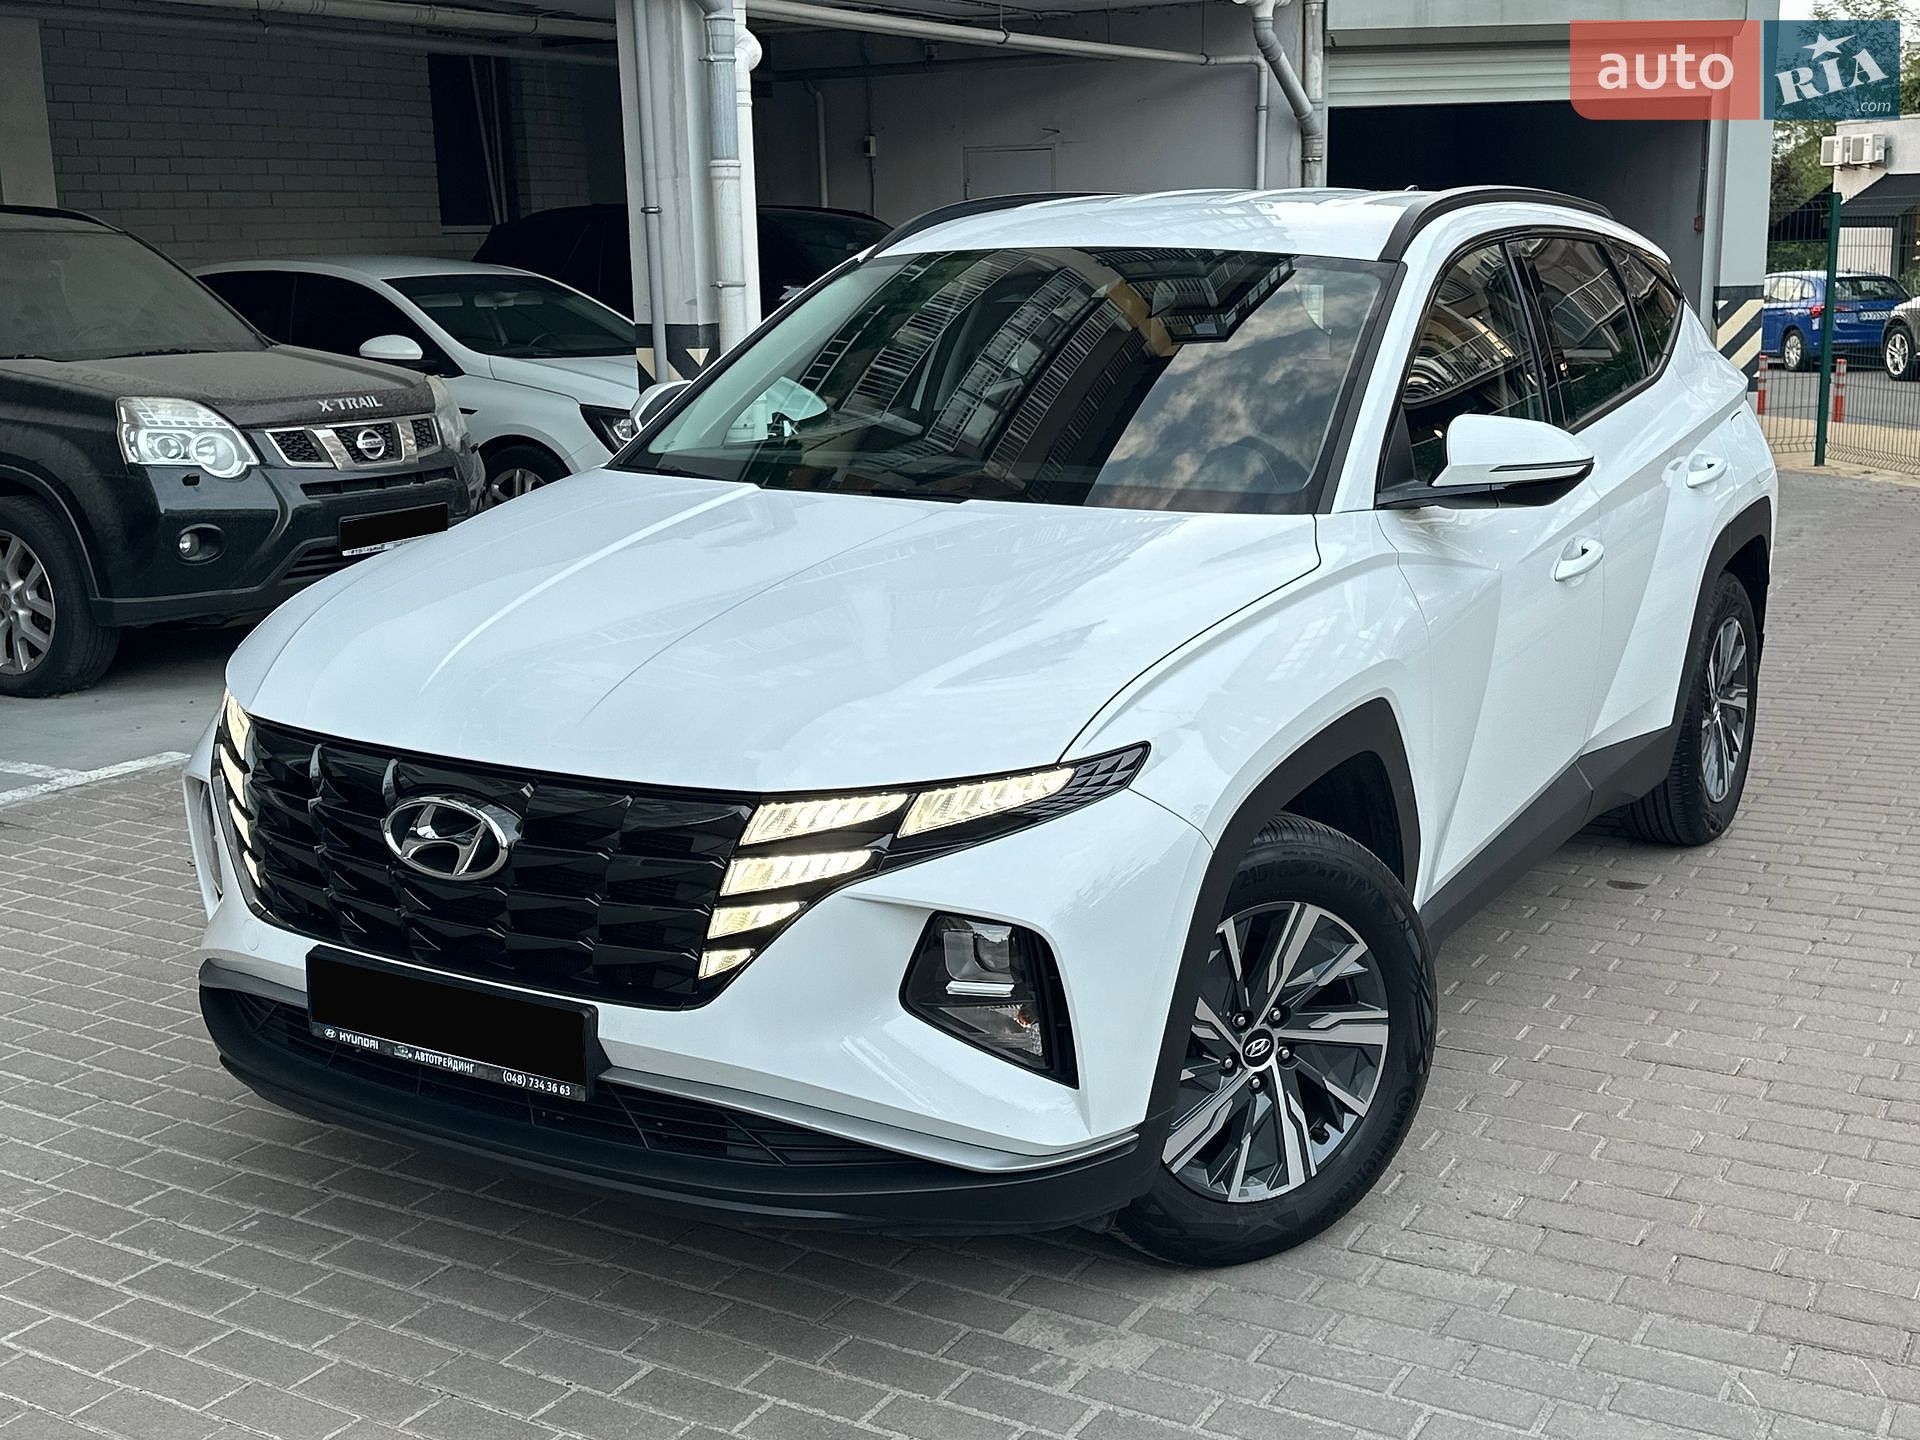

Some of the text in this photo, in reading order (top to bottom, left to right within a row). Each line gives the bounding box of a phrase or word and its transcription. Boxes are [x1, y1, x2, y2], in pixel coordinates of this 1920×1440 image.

[317, 395, 384, 413] X-TRAIL
[339, 1031, 379, 1050] HYUNDAI
[414, 1050, 475, 1073] АВТОТРЕЙДИНГ
[502, 1069, 571, 1096] (048) 734 36 63
